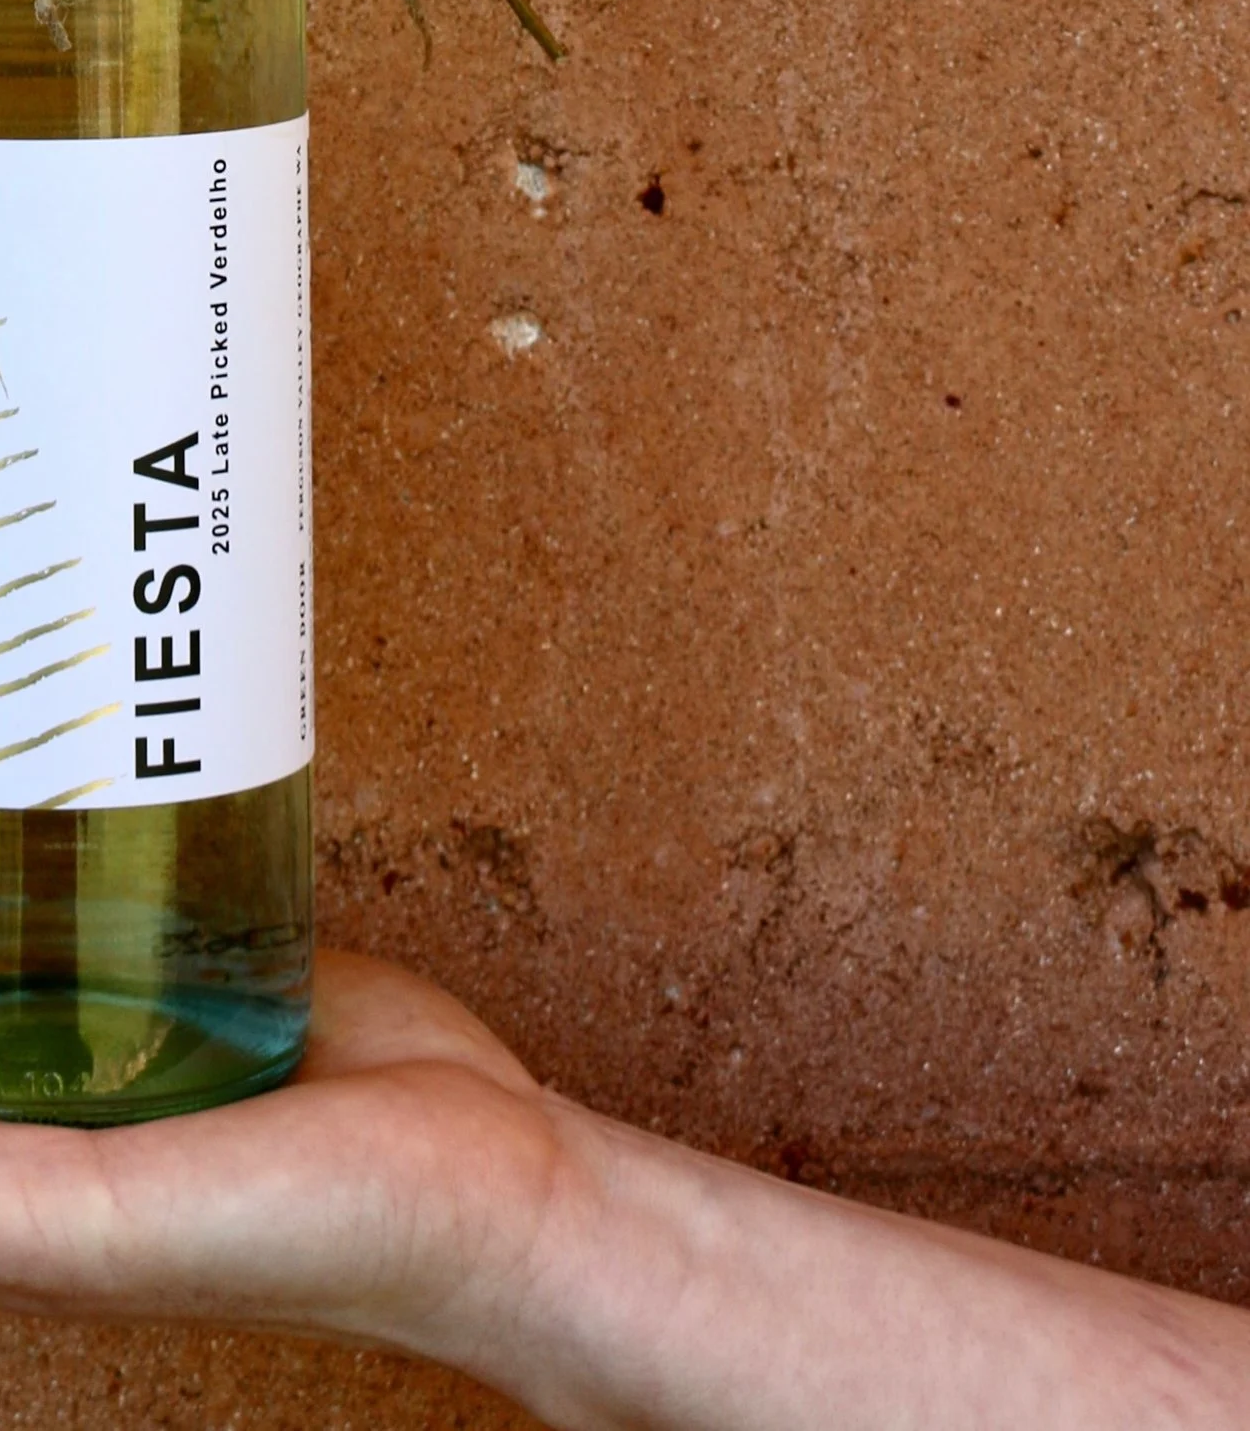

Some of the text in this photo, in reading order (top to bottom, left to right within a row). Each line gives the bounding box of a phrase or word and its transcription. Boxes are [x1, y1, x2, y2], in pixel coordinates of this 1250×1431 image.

[209, 158, 230, 555] 2025 Late Picked Verdelho
[295, 144, 305, 532] FERGUSON VALLEY GEOGRAPHE WA
[132, 430, 202, 780] FIESTA
[298, 561, 307, 741] GREEN DOOR
